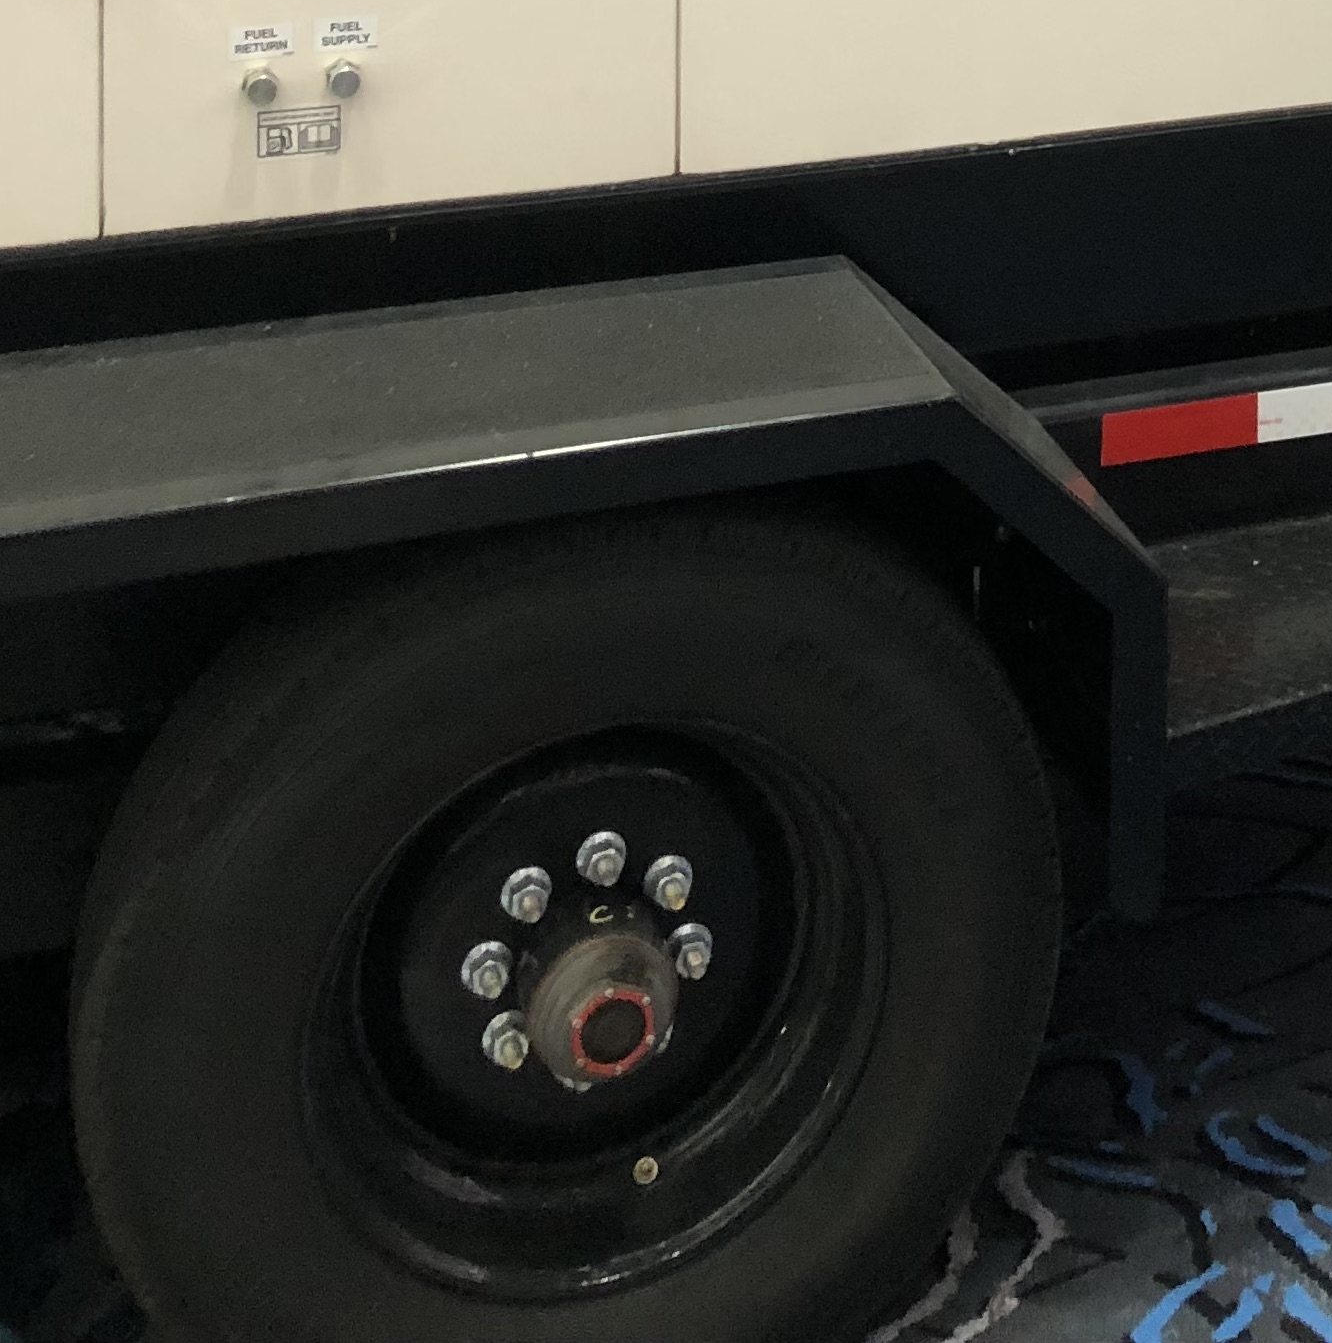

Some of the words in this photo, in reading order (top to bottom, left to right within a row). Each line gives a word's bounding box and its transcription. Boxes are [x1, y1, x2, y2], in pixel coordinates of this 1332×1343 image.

[244, 27, 278, 40] FUEL
[330, 21, 363, 32] FUEL
[234, 39, 288, 54] RETURN
[321, 32, 371, 47] SUPPLY
